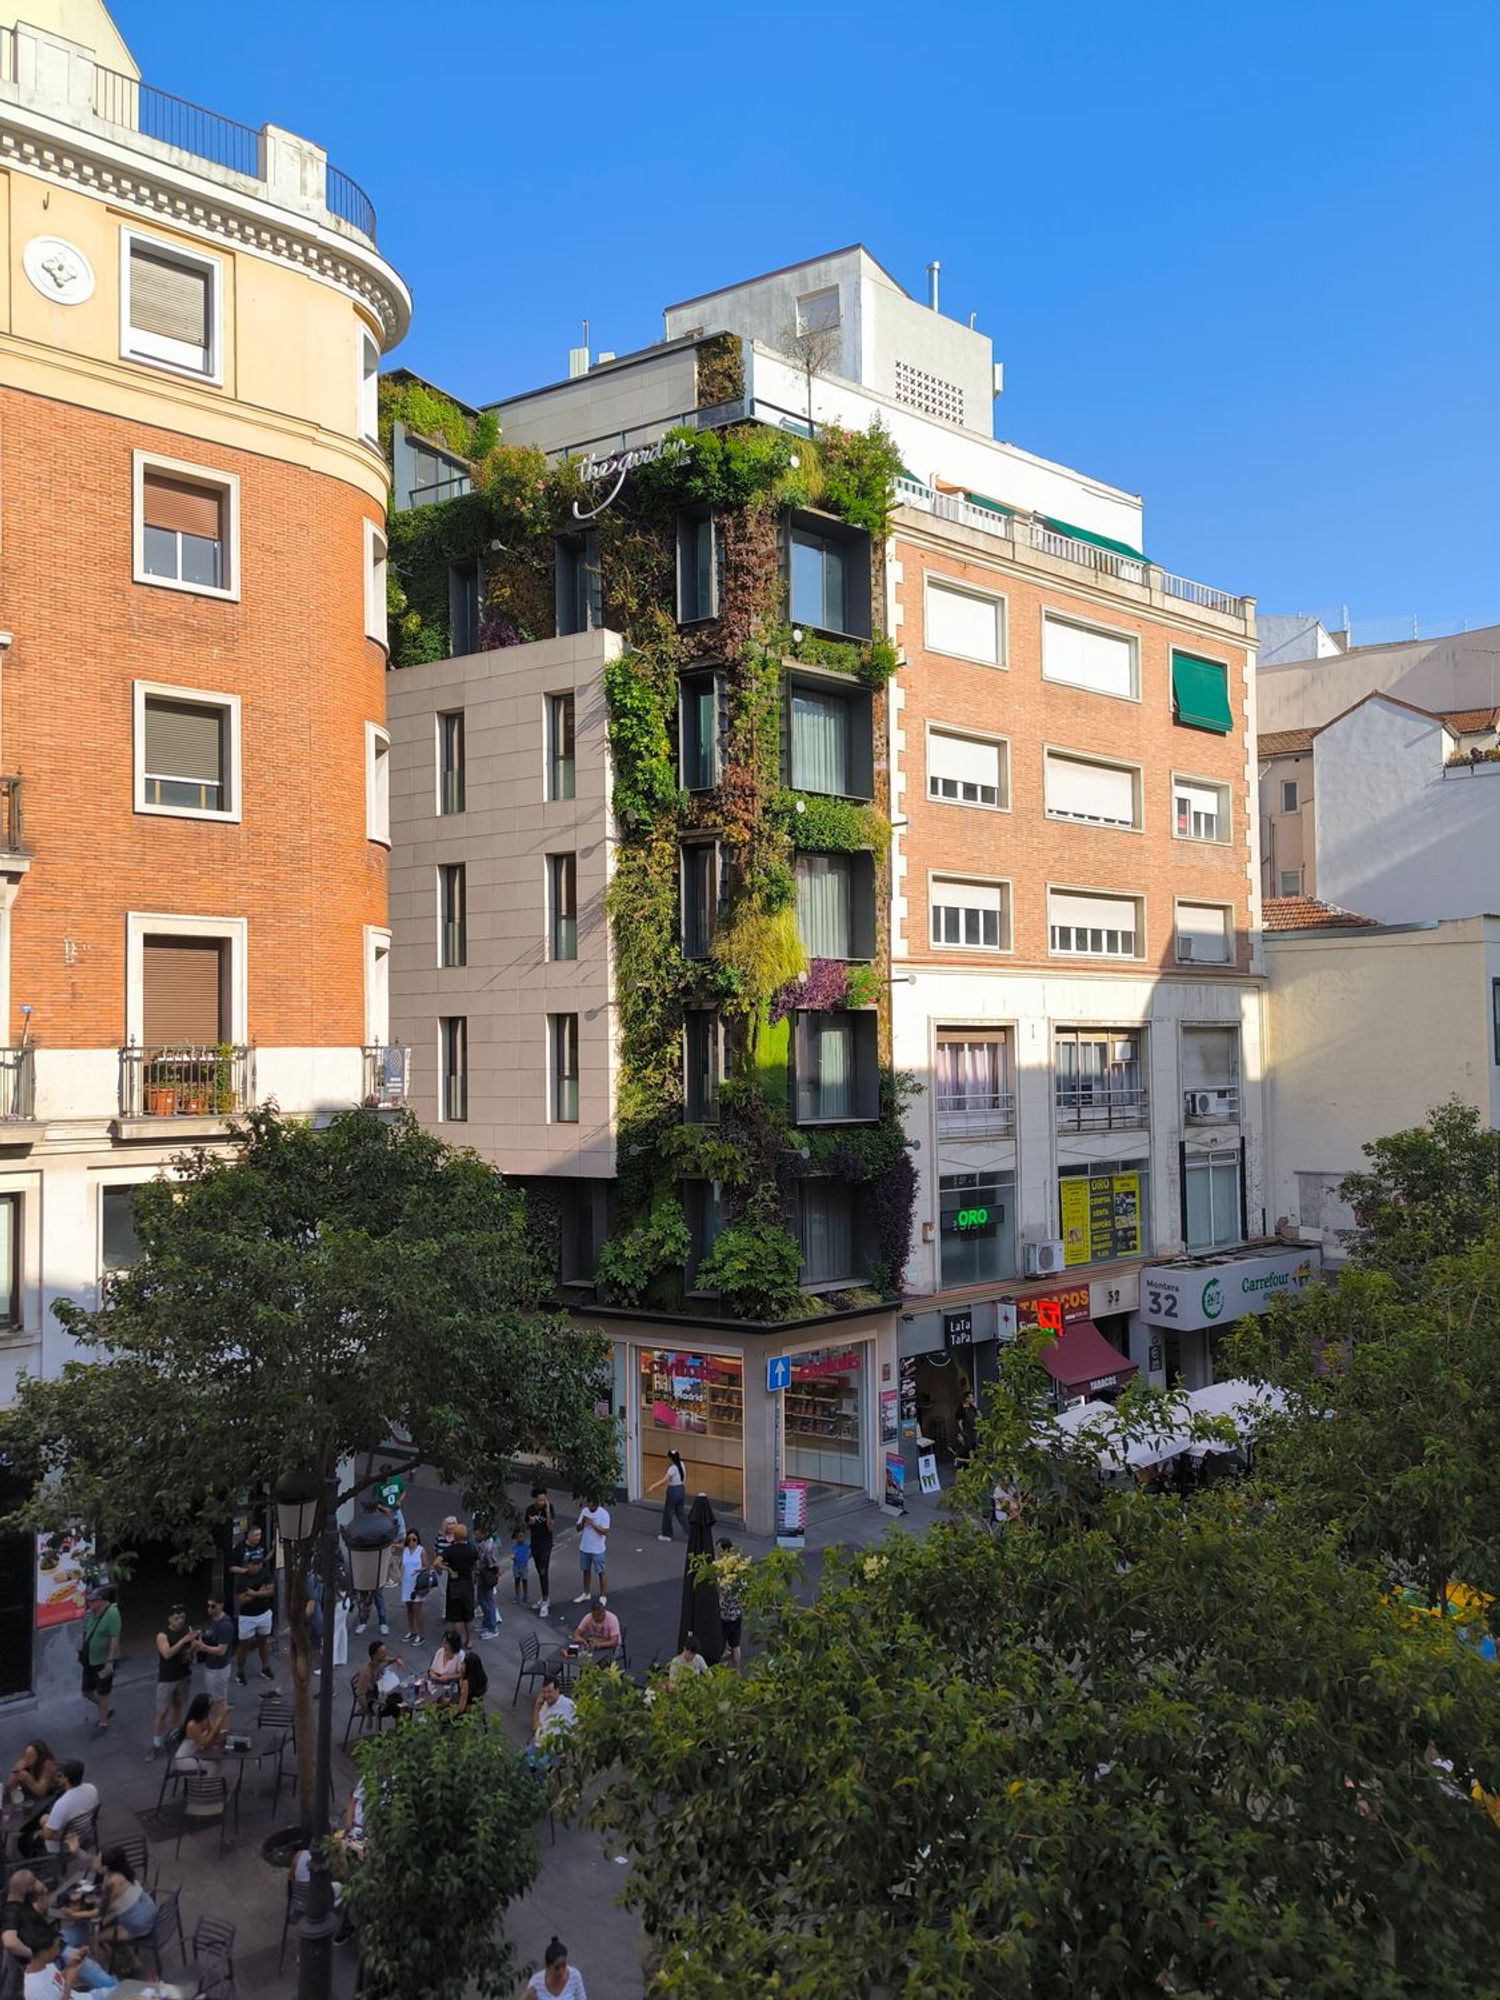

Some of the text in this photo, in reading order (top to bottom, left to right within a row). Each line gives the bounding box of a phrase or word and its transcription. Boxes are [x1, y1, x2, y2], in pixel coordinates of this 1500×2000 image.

[958, 1208, 988, 1227] ORO
[1146, 1279, 1180, 1293] Montera
[1241, 1272, 1290, 1294] Carrefour
[1107, 1289, 1120, 1304] 32
[1148, 1291, 1178, 1319] 32
[950, 1320, 971, 1333] LaTa
[950, 1333, 971, 1345] TaPa
